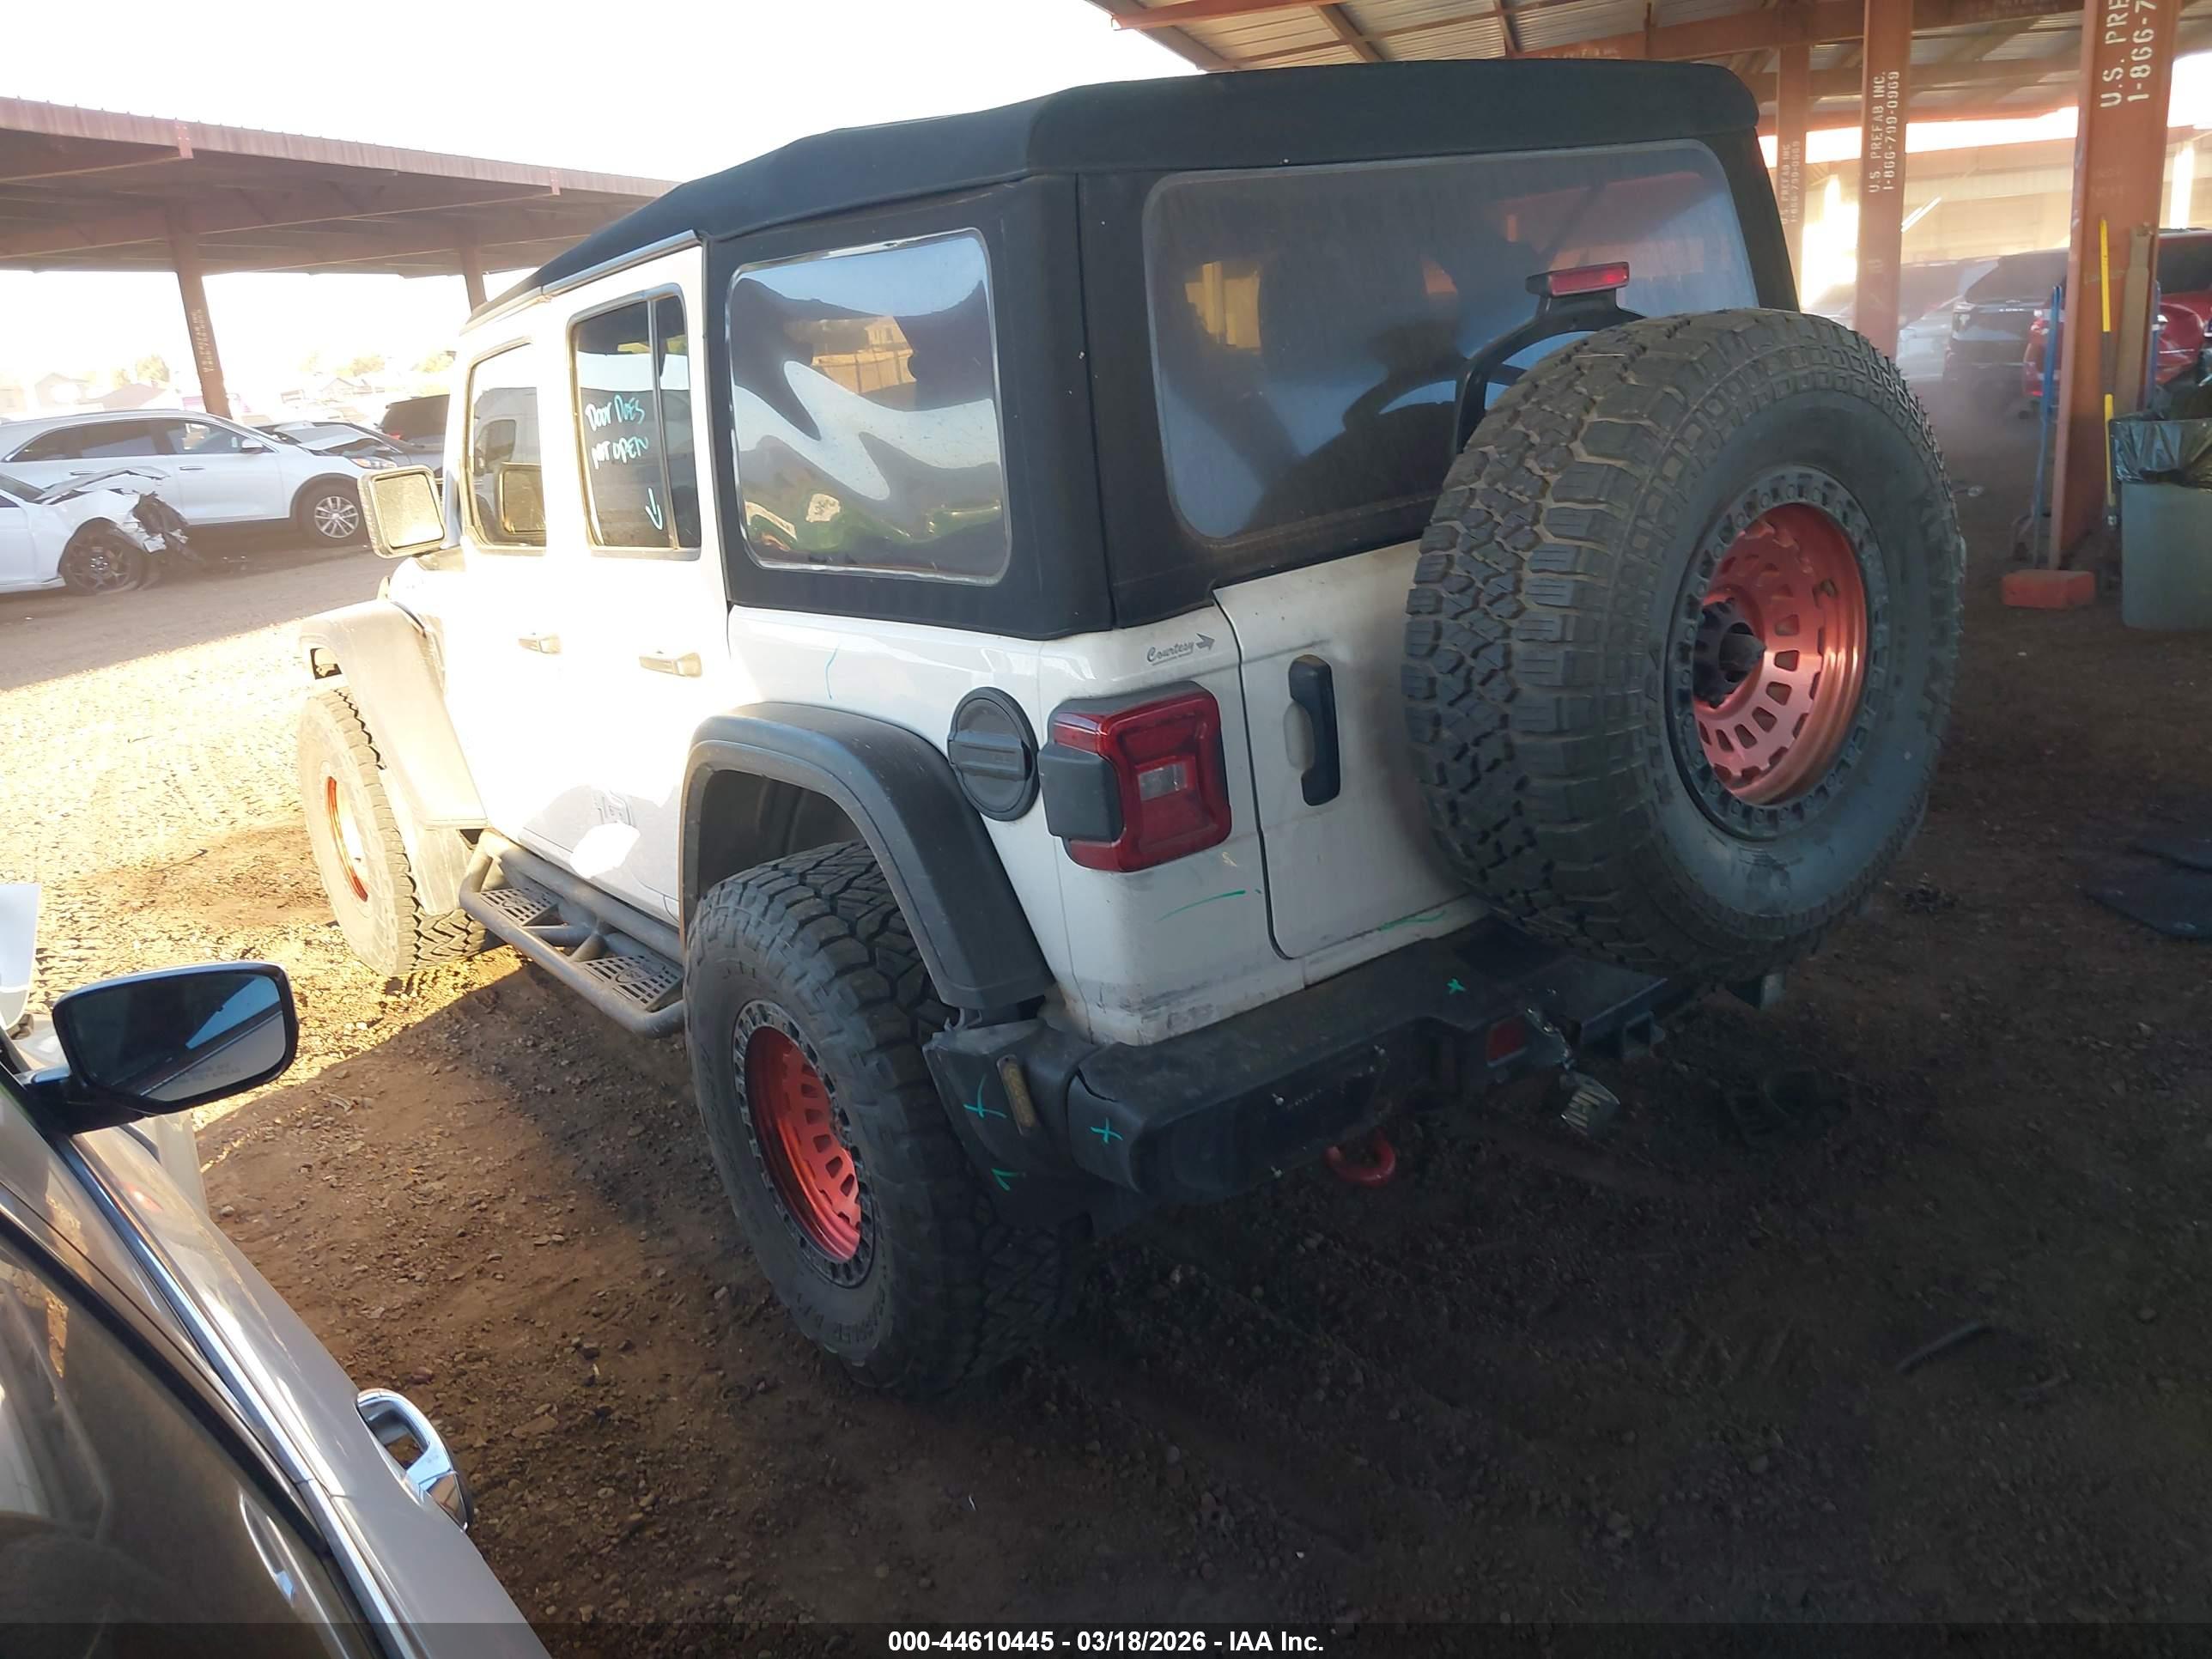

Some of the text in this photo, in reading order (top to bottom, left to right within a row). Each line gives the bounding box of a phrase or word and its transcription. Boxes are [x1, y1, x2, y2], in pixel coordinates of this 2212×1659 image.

[1872, 71, 1886, 99] INC.
[2100, 56, 2125, 107] U.S.
[1870, 105, 1884, 160] PREFAB
